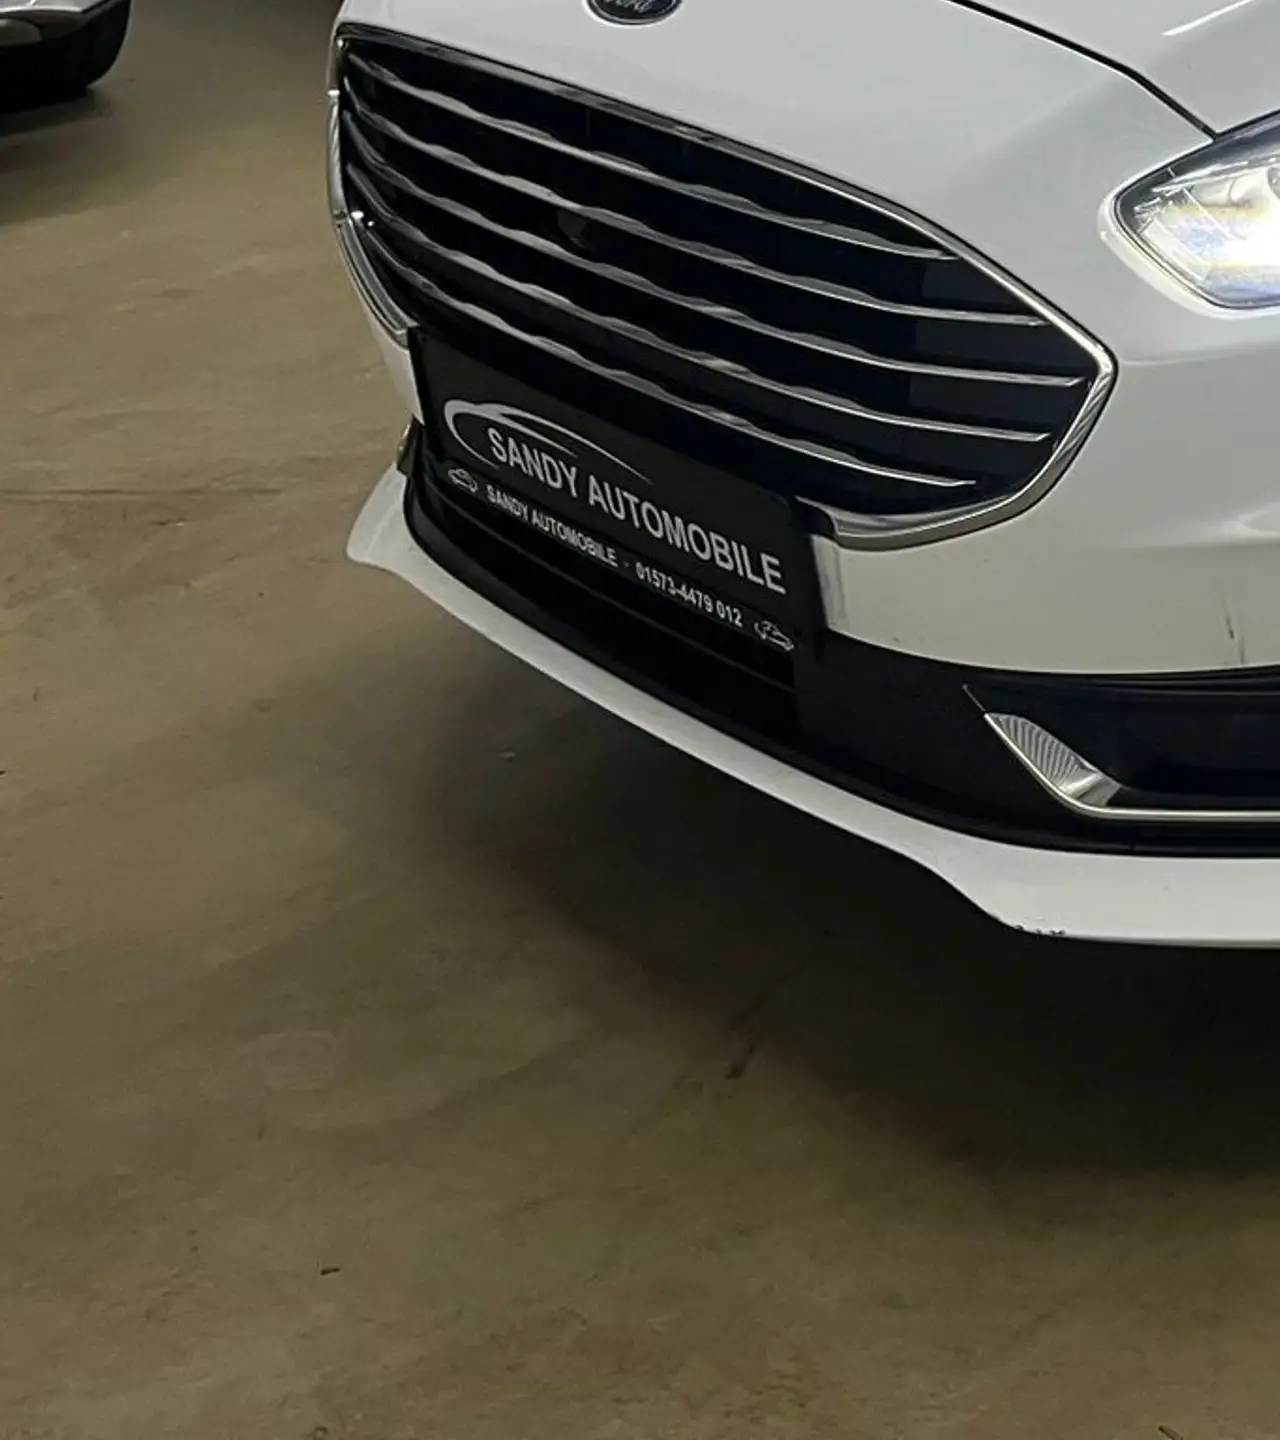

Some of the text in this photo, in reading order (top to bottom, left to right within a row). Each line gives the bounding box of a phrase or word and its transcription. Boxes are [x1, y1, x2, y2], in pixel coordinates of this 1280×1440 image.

[486, 427, 786, 594] SANDY AUTOMOBILE
[486, 484, 529, 521] SANDY
[532, 509, 618, 567] AUTOMOBILE
[715, 598, 744, 628] 012
